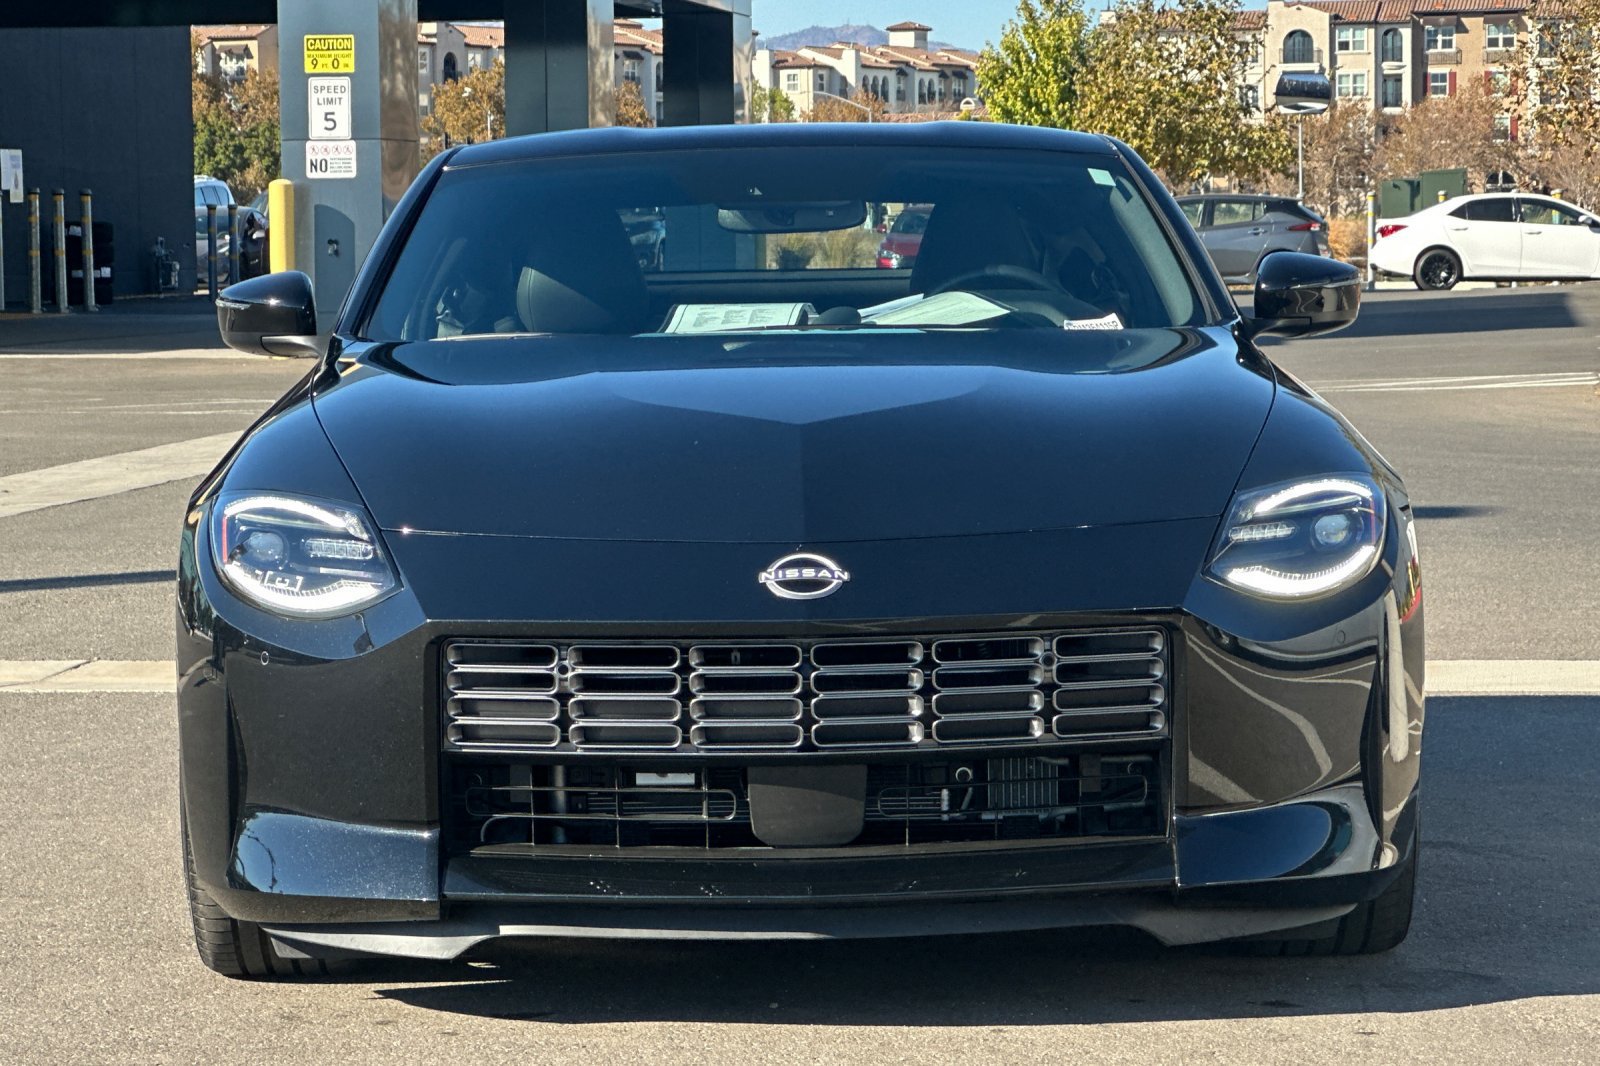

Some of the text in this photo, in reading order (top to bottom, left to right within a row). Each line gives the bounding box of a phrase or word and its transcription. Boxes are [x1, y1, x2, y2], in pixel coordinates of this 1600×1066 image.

[307, 38, 351, 50] CAUTION
[311, 57, 318, 69] 9
[331, 57, 340, 69] 0
[313, 85, 346, 94] SPEED
[316, 97, 343, 106] LIMIT
[324, 111, 337, 131] 5
[310, 158, 328, 173] NO
[760, 568, 848, 582] NISSAN
